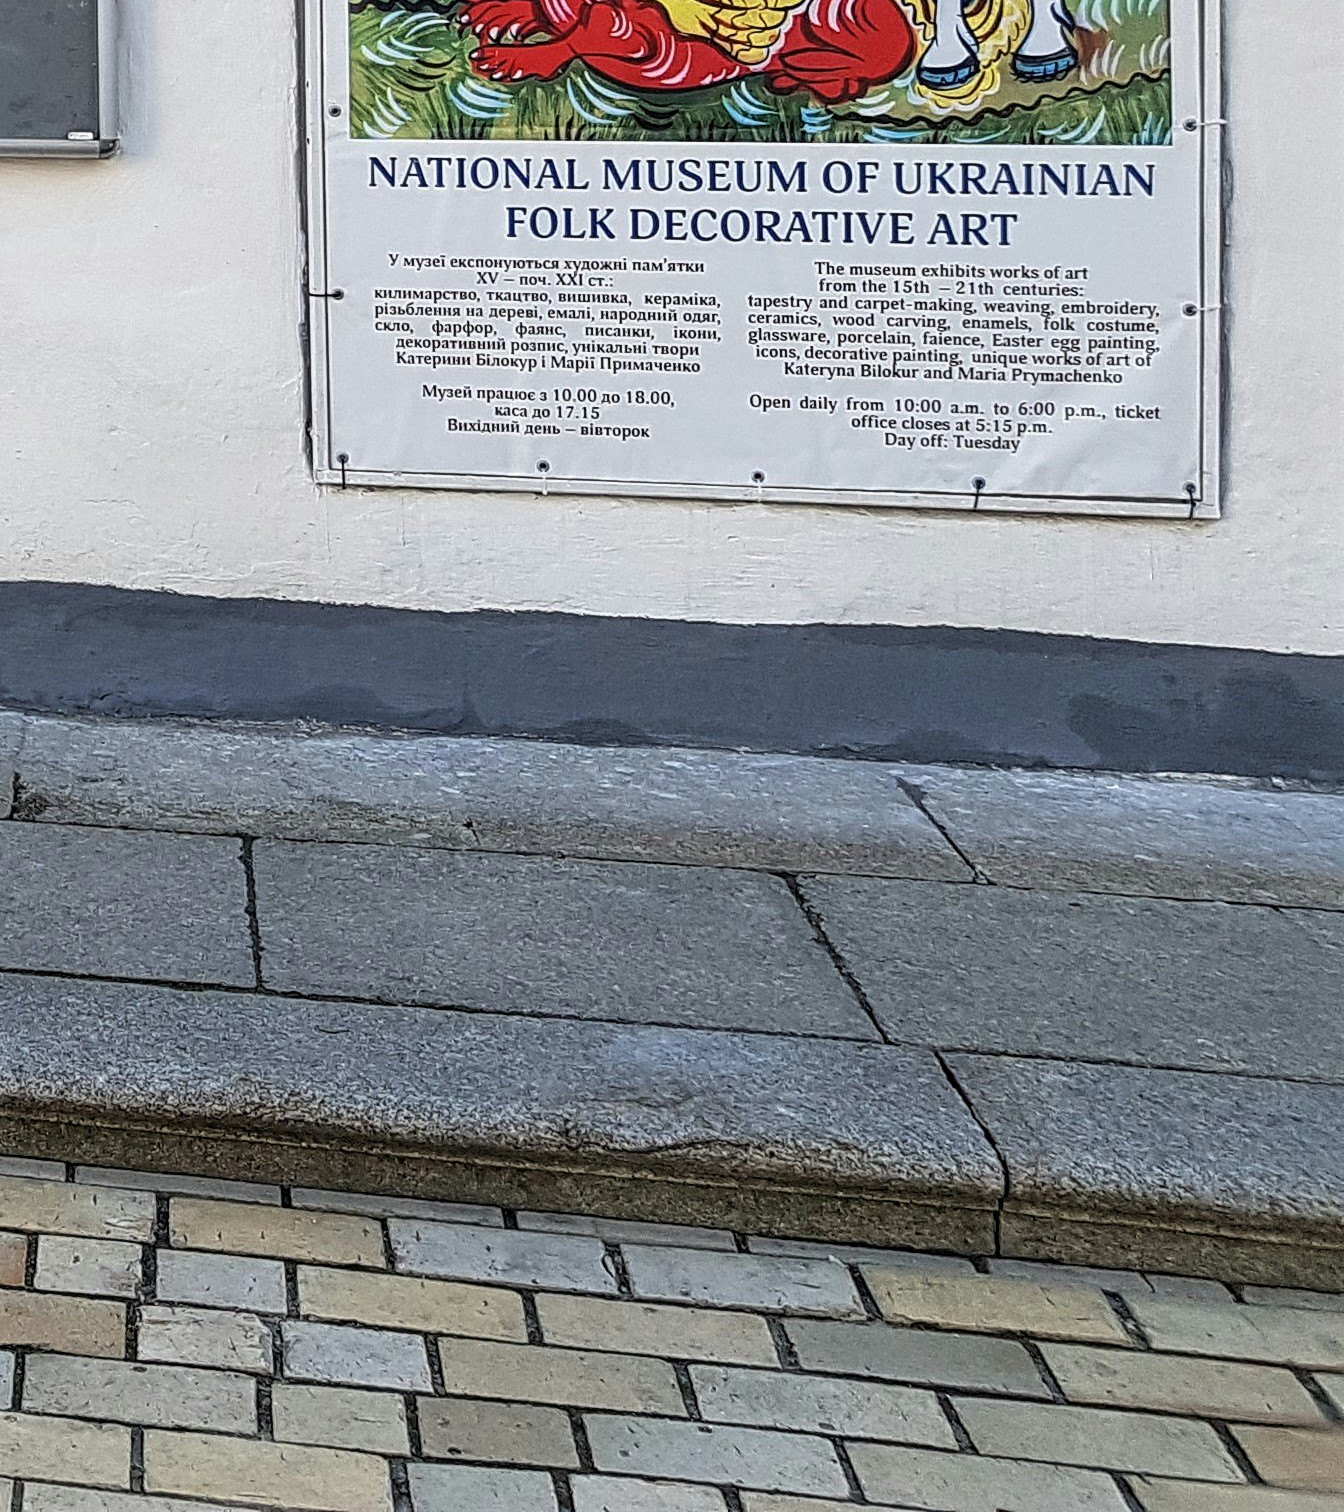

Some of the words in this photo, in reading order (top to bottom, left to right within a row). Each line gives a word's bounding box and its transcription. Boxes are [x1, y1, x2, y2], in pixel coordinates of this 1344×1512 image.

[369, 156, 590, 190] NATIONAL
[602, 159, 808, 193] MUSEUM
[822, 160, 880, 194] OF
[893, 162, 1156, 197] UKRAINIAN
[506, 206, 616, 240] FOLK
[629, 208, 915, 245] DECORATIVE
[926, 213, 1018, 246] ART
[388, 253, 399, 266] У
[403, 254, 446, 271] музеї
[450, 258, 559, 273] експонуються
[563, 257, 627, 278] художні
[814, 261, 845, 276] The
[849, 265, 917, 277] museum
[921, 263, 986, 278] exhibits
[989, 265, 1039, 279] works
[1043, 265, 1061, 279] of
[1064, 267, 1088, 280] art
[519, 276, 551, 286] поч.
[588, 277, 613, 287] ст.:
[818, 278, 857, 292] from
[862, 279, 887, 293] the
[893, 280, 930, 294] 15th
[955, 280, 994, 295] 21th
[1003, 284, 1084, 297] centuries:
[374, 289, 481, 308] килимарство,
[486, 291, 552, 305] ткацтво,
[558, 293, 632, 307] вишивка,
[644, 292, 721, 309] кераміка,
[747, 295, 813, 315] tapestry
[819, 295, 848, 309] and
[854, 297, 977, 318] carpet-making,
[983, 299, 1055, 321] weaving,
[1061, 300, 1160, 320] embroidery,
[374, 301, 461, 319] різьблення
[465, 307, 483, 317] на
[488, 305, 543, 322] дереві,
[547, 306, 595, 322] емалі,
[600, 309, 678, 325] народний
[682, 312, 721, 326] одяг,
[747, 311, 822, 327] ceramics,
[832, 312, 875, 327] wood
[886, 314, 951, 336] carving,
[962, 316, 1032, 333] enamels,
[1040, 312, 1075, 331] folk
[1086, 320, 1159, 334] costume,
[374, 321, 414, 334] скло,
[431, 319, 497, 338] фарфор,
[515, 321, 567, 339] фаянс,
[585, 326, 655, 340] писанки,
[673, 325, 721, 342] ікони,
[395, 337, 506, 356] декоративний
[510, 341, 569, 355] розпис,
[571, 339, 647, 357] унікальні
[651, 345, 700, 360] твори
[748, 327, 831, 348] glassware,
[837, 330, 916, 351] porcelain,
[923, 331, 985, 349] faience,
[992, 333, 1044, 348] Easter
[1050, 338, 1081, 357] egg
[1088, 337, 1160, 359] painting,
[396, 351, 471, 369] Катерини
[475, 353, 538, 372] Білокур
[541, 355, 546, 368] і
[551, 355, 595, 373] Марії
[600, 356, 701, 375] Примаченко
[756, 344, 801, 361] icons,
[804, 345, 888, 361] decorative
[892, 348, 963, 370] painting,
[971, 350, 1028, 371] unique
[1031, 346, 1082, 366] works
[1085, 352, 1103, 366] of
[1106, 354, 1130, 367] art
[1135, 349, 1156, 367] of
[784, 361, 855, 381] Kateryna
[860, 359, 920, 379] Bilokur
[923, 366, 953, 380] and
[958, 366, 1006, 381] Maria
[1012, 368, 1123, 386] Prymachenko
[422, 384, 472, 402] Музей
[477, 389, 536, 404] працює
[539, 391, 548, 402] з
[553, 388, 597, 403] 10.00
[600, 393, 621, 404] до
[627, 390, 675, 407] 18.00,
[749, 394, 791, 413] Open
[799, 395, 838, 414] daily
[846, 396, 884, 412] from
[895, 398, 942, 414] 10:00
[950, 404, 984, 415] a.m.
[993, 403, 1010, 416] to
[1018, 402, 1055, 416] 6:00
[1064, 406, 1106, 421] p.m.,
[1114, 404, 1160, 420] ticket
[494, 406, 528, 418] каса
[531, 408, 551, 419] до
[556, 405, 600, 420] 17.15
[448, 418, 520, 433] Вихідний
[524, 424, 561, 435] день
[580, 422, 650, 442] вівторок
[851, 414, 897, 429] office
[901, 416, 951, 431] closes
[955, 419, 971, 432] at
[975, 418, 1012, 433] 5:15
[1017, 423, 1052, 437] p.m.
[884, 432, 916, 451] Day
[920, 433, 948, 448] off:
[952, 434, 1021, 454] Tuesday
